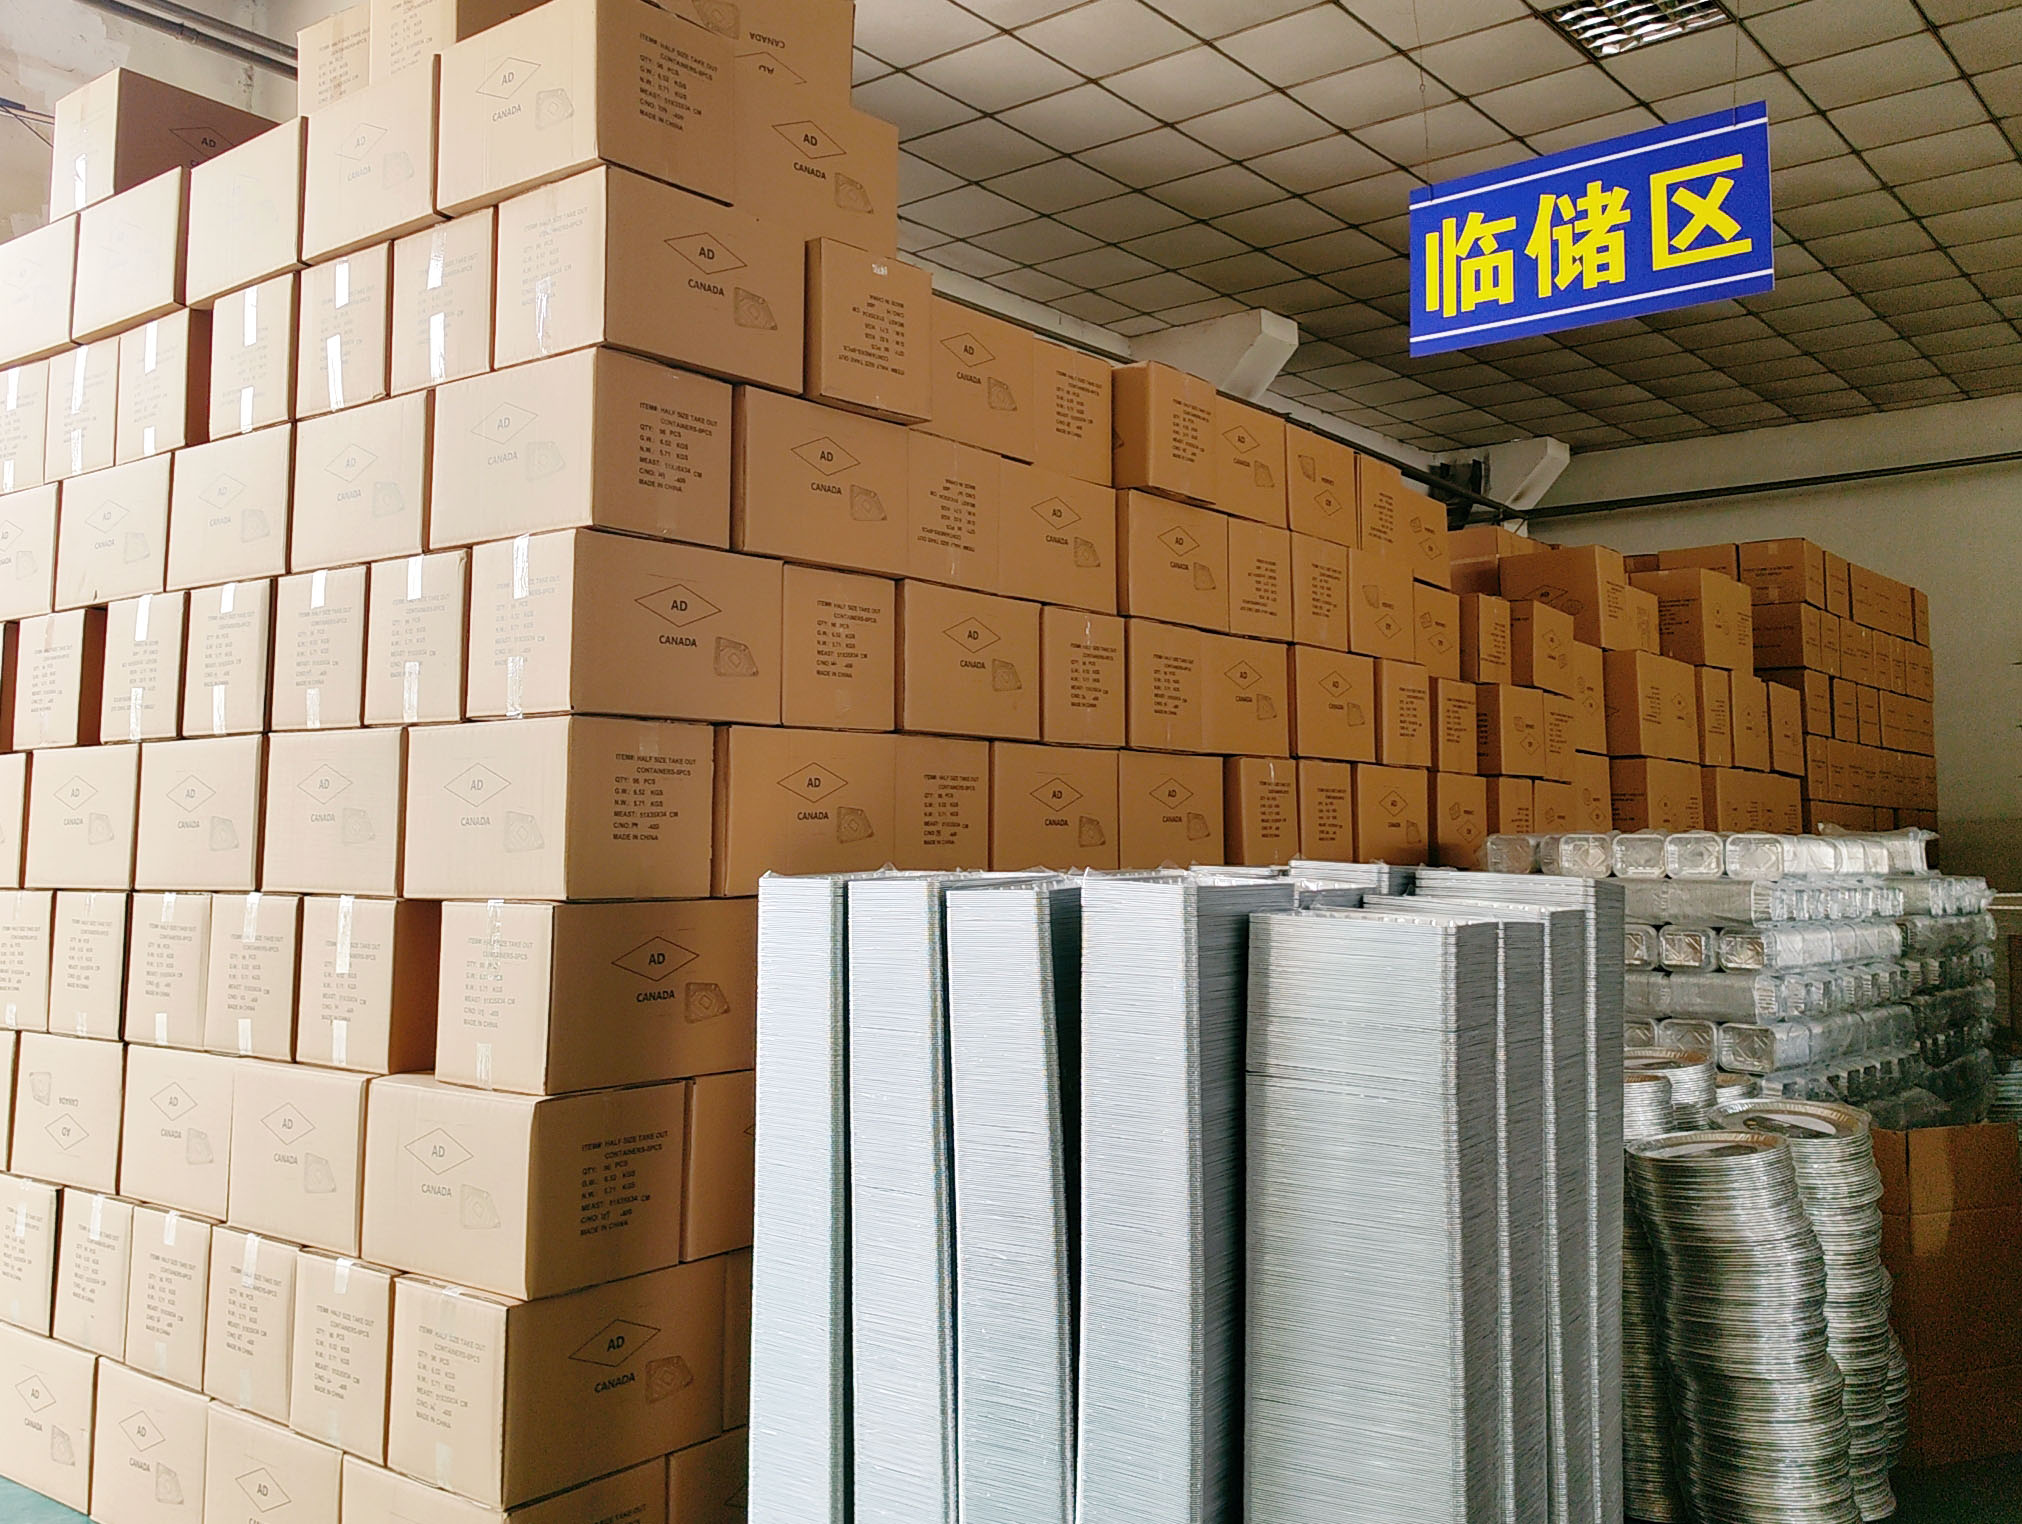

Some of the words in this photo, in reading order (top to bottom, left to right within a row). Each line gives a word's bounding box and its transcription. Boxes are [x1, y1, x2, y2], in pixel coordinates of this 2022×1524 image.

[502, 72, 514, 86] AD
[493, 104, 521, 122] CANADA
[201, 138, 216, 147] AD
[803, 134, 817, 146] AD
[794, 162, 826, 179] CANADA
[1425, 153, 1753, 318] 临储区
[699, 247, 714, 259] AD
[688, 279, 724, 296] CANADA
[964, 345, 974, 355] AD
[957, 372, 981, 384] CANADA
[497, 417, 510, 430] AD
[488, 451, 517, 465] CANADA
[820, 451, 833, 462] AD
[811, 483, 842, 495] CANADA
[1052, 509, 1062, 518] AD
[671, 600, 687, 611] AD
[968, 630, 979, 640] AD
[659, 635, 697, 647] CANADA
[960, 660, 986, 669] CANADA
[319, 779, 329, 789] AD
[471, 779, 483, 790] AD
[807, 778, 821, 787] AD
[71, 788, 80, 797] AD
[186, 789, 195, 798] AD
[1052, 791, 1062, 799] AD
[311, 814, 335, 822] CANADA
[461, 817, 490, 826] CANADA
[797, 812, 829, 820] CANADA
[178, 821, 200, 829] CANADA
[648, 953, 665, 965] AD
[636, 990, 674, 1002] CANADA
[168, 1096, 178, 1106] AD
[282, 1118, 293, 1129] AD
[161, 1128, 181, 1138] CANADA
[432, 1145, 445, 1157] AD
[274, 1153, 298, 1164] CANADA
[422, 1184, 452, 1197] CANADA
[607, 1336, 624, 1352] AD
[594, 1373, 635, 1393] CANADA
[31, 1389, 39, 1399] AD
[25, 1418, 42, 1431] CANADA
[137, 1426, 146, 1437] AD
[129, 1458, 150, 1473] CANADA
[257, 1484, 268, 1496] AD
